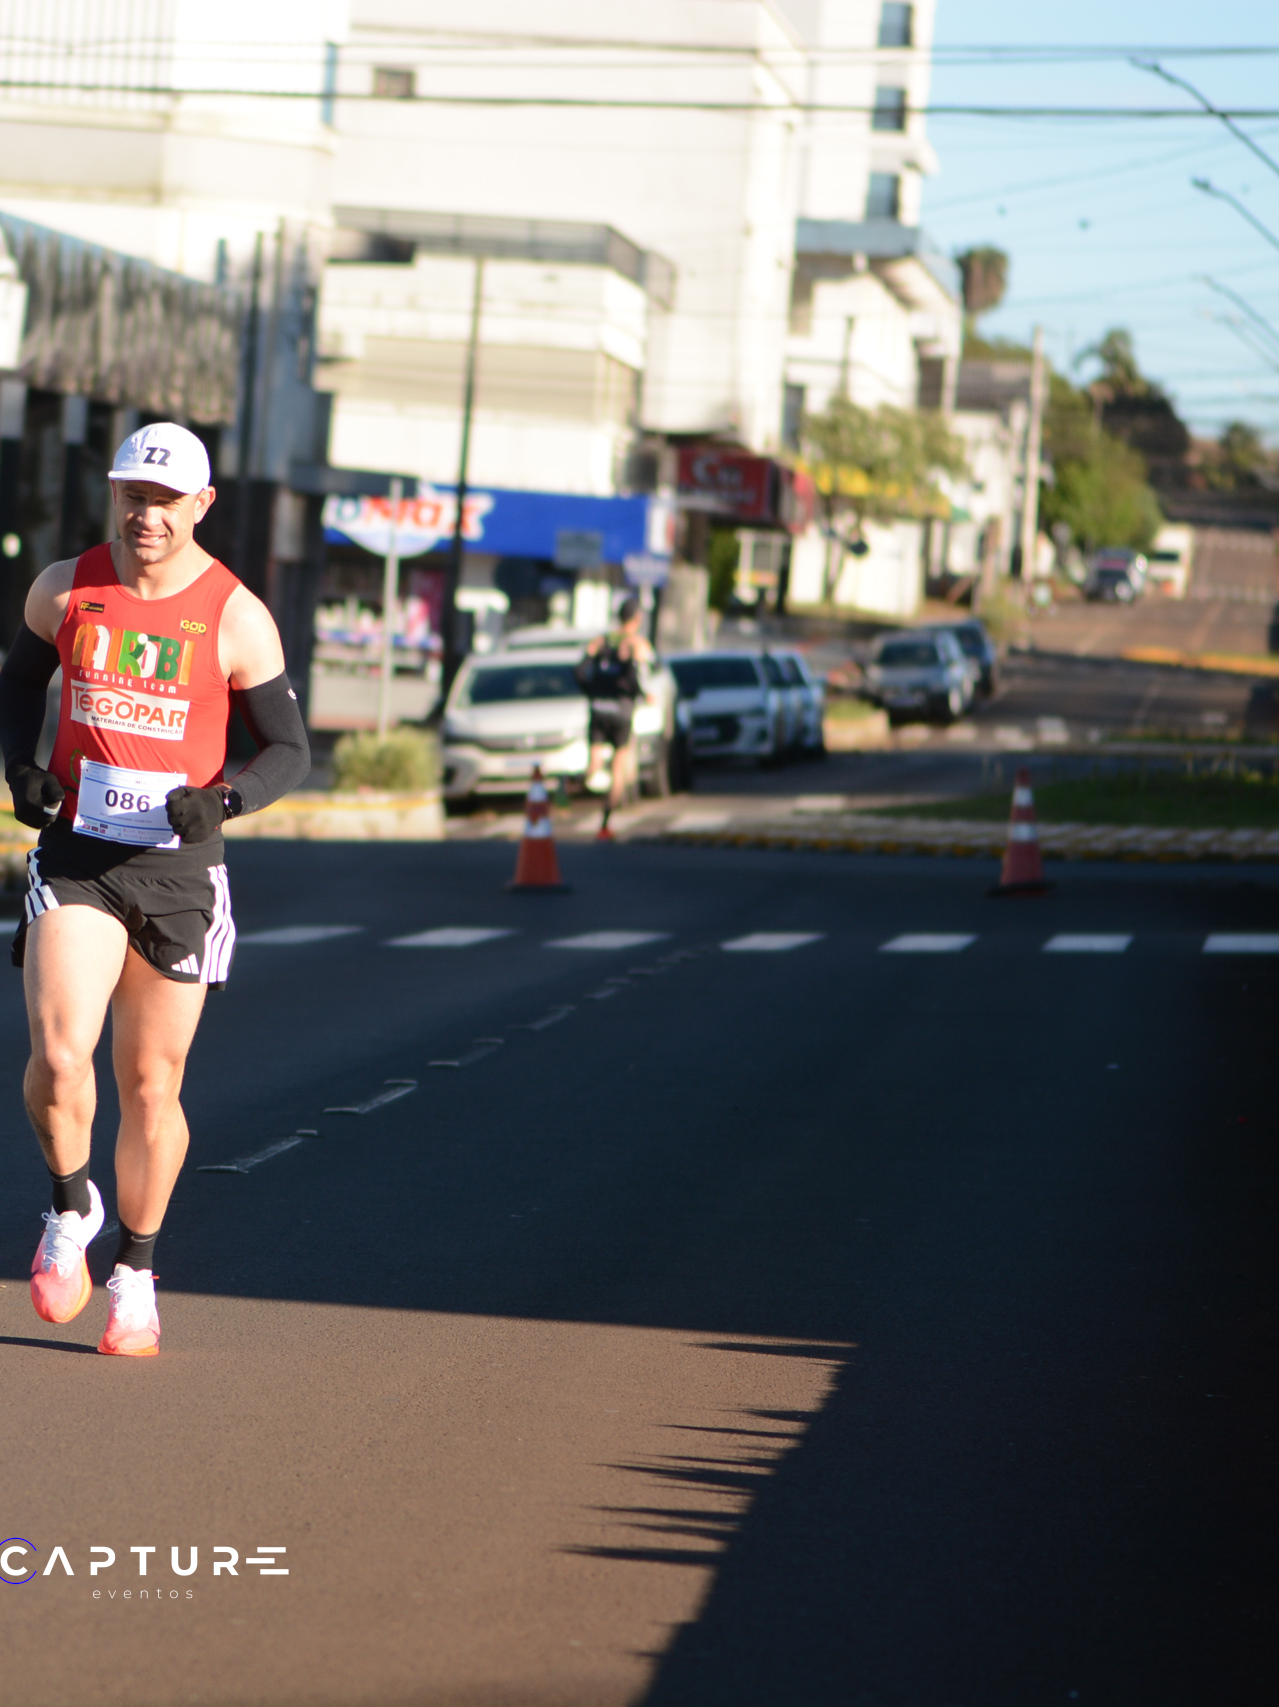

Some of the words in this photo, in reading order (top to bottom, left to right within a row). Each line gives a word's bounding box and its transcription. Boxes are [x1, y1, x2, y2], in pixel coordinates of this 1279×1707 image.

[79, 669, 133, 688] running
[144, 680, 177, 694] team
[91, 715, 126, 727] MATERIAIS
[137, 724, 183, 735] CONSTRUÇÃO
[104, 789, 151, 813] 086
